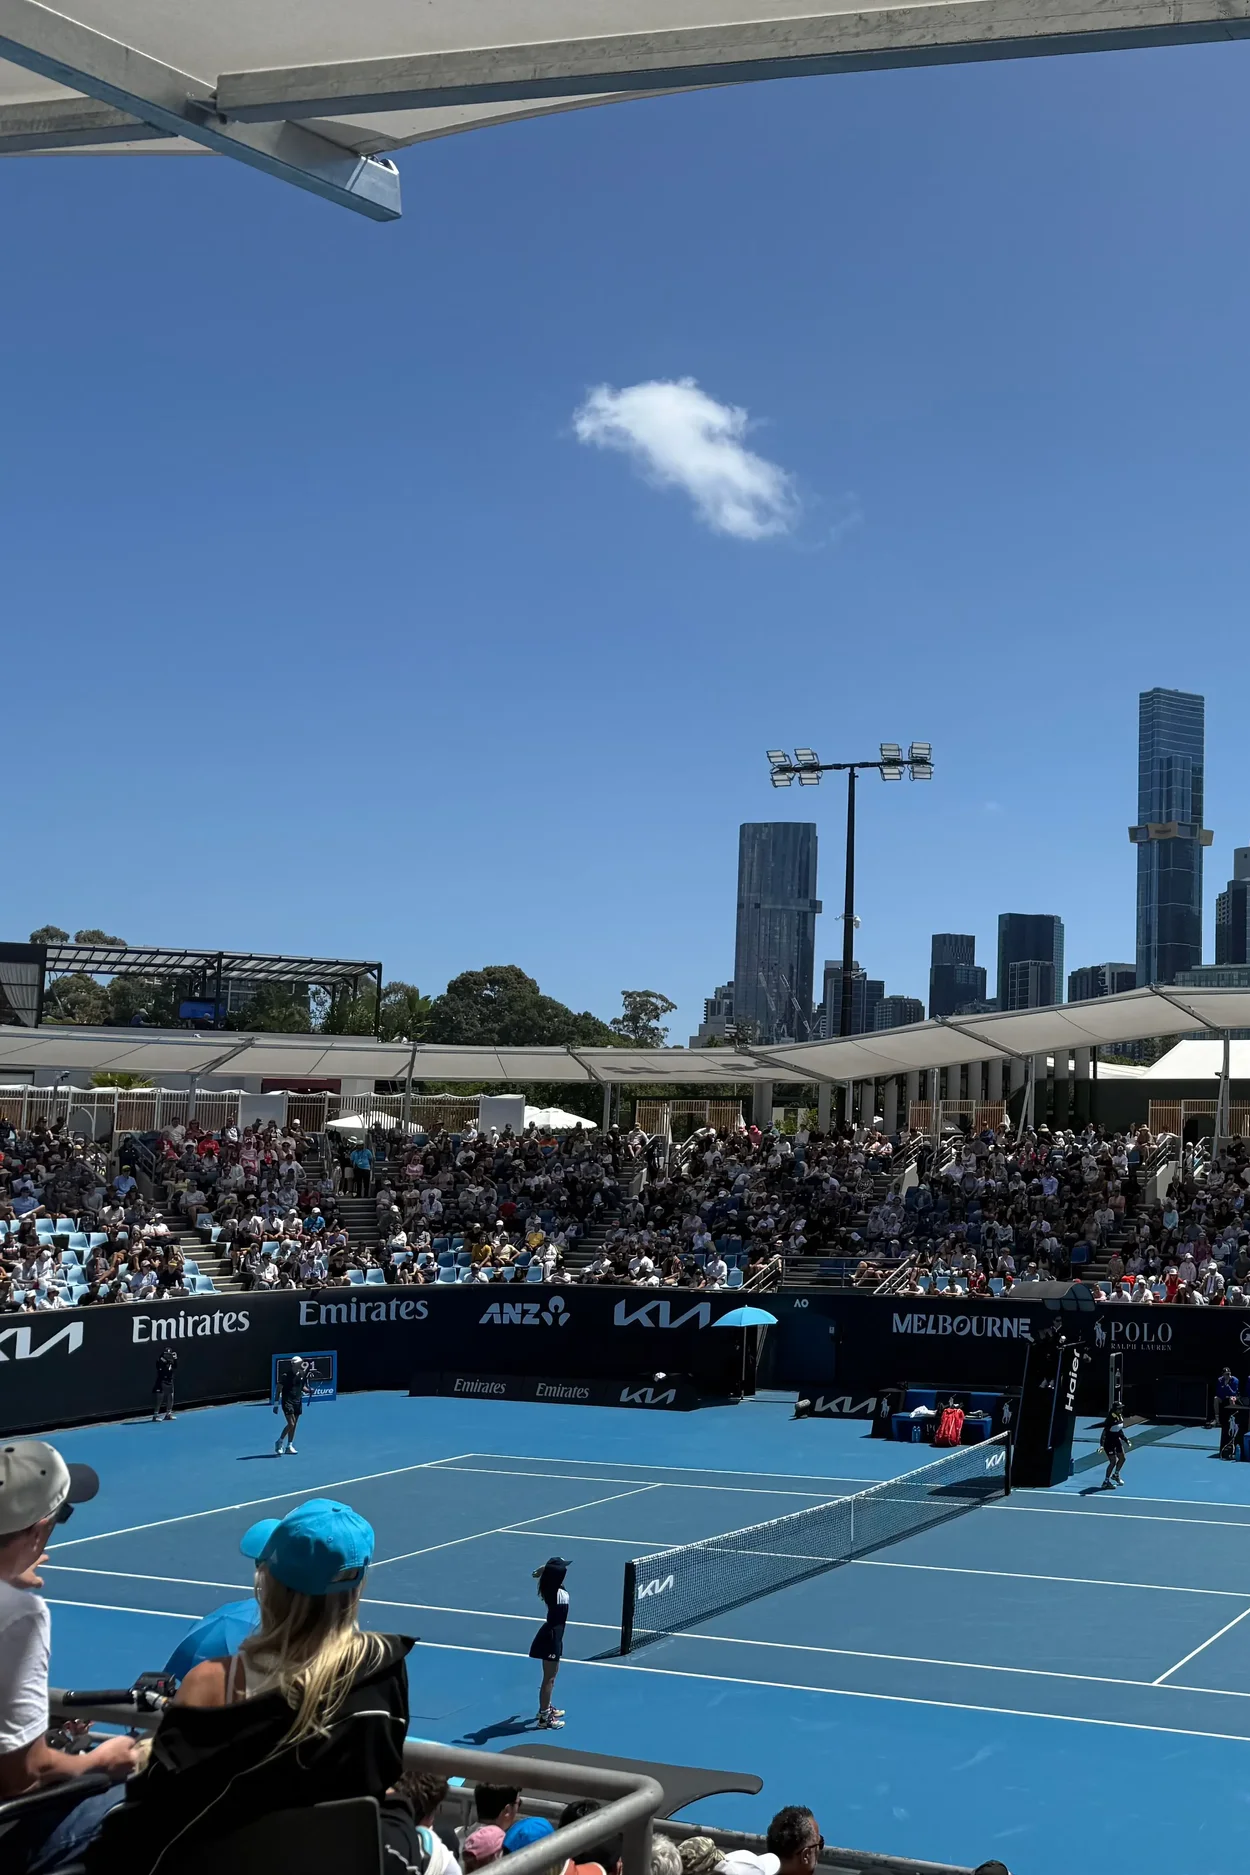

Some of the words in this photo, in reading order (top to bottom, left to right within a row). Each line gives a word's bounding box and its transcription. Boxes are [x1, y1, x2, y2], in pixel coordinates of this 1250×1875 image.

[299, 1296, 429, 1326] Emirates
[478, 1302, 541, 1325] ANZ
[614, 1299, 711, 1329] KIA
[793, 1298, 809, 1308] AO
[132, 1309, 250, 1343] Emirates
[892, 1312, 1034, 1342] MELBOURNE
[1110, 1321, 1173, 1343] POLO
[1110, 1342, 1137, 1350] RALPH
[1140, 1343, 1172, 1351] LAUREN
[453, 1378, 507, 1395] Emirates
[535, 1382, 590, 1399] Emirates
[1064, 1347, 1081, 1412] Haier
[619, 1386, 677, 1405] KIA
[814, 1395, 878, 1414] KIA
[985, 1450, 1006, 1470] KIA
[637, 1574, 674, 1600] KIA
